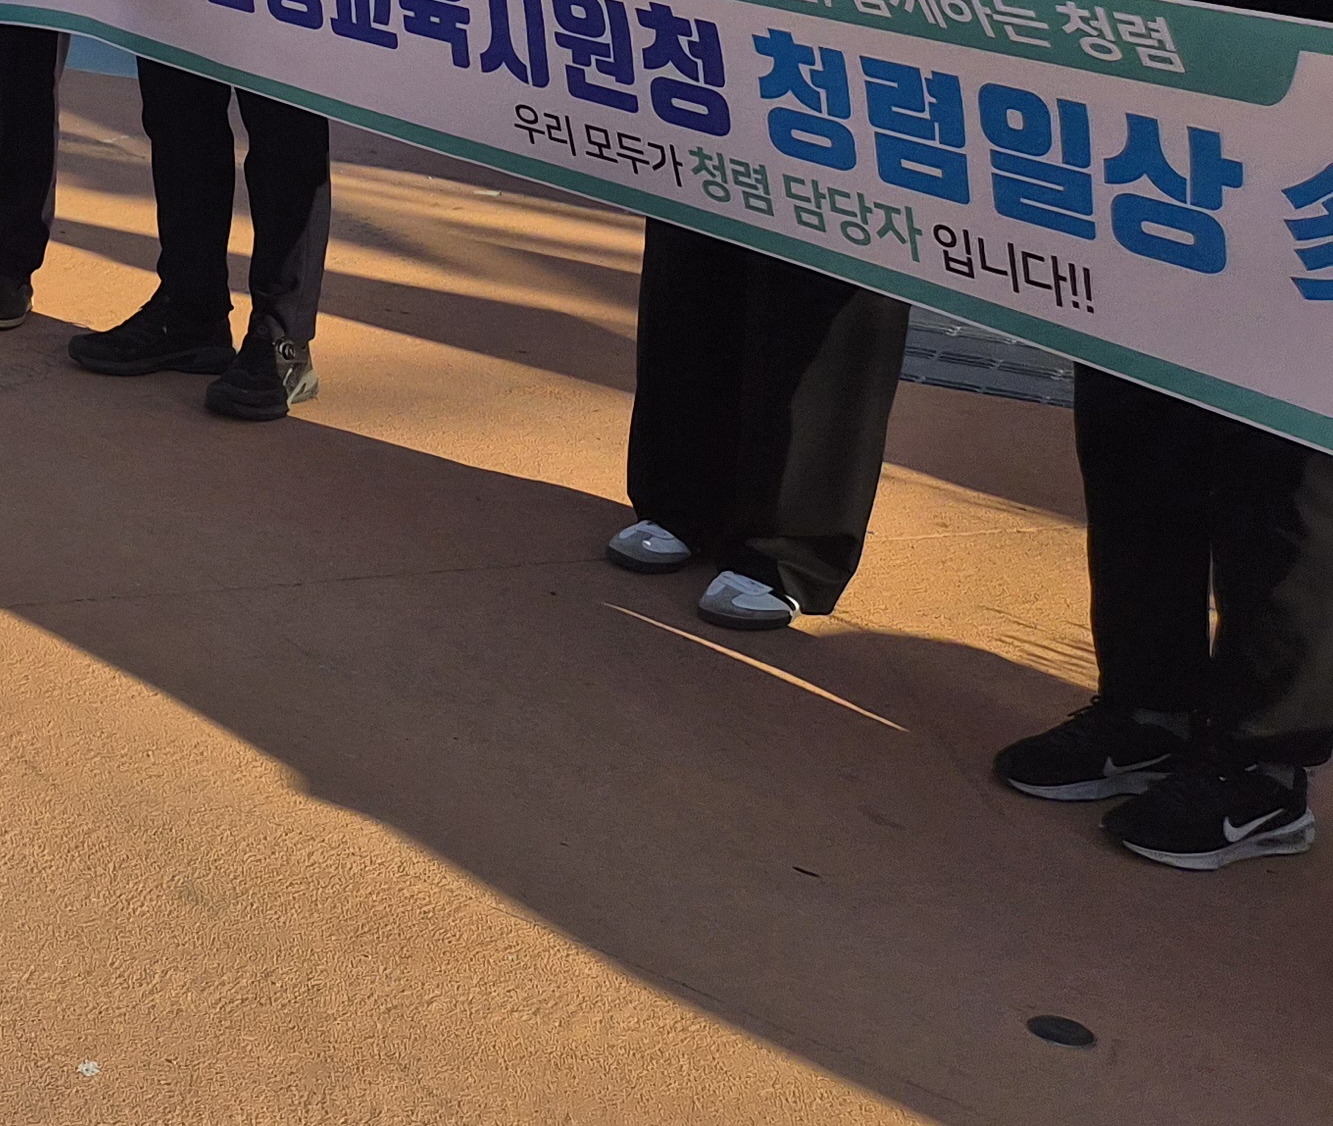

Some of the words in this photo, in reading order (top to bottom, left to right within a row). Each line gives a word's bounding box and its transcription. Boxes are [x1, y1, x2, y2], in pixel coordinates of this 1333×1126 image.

[1055, 1, 1186, 74] 청렴
[513, 102, 576, 157] 우리
[584, 124, 685, 187] 모두가
[687, 145, 775, 217] 청렴
[784, 170, 924, 264] 담당자
[932, 223, 1095, 315] 입니다!!
[752, 28, 1244, 275] 청렴일상
